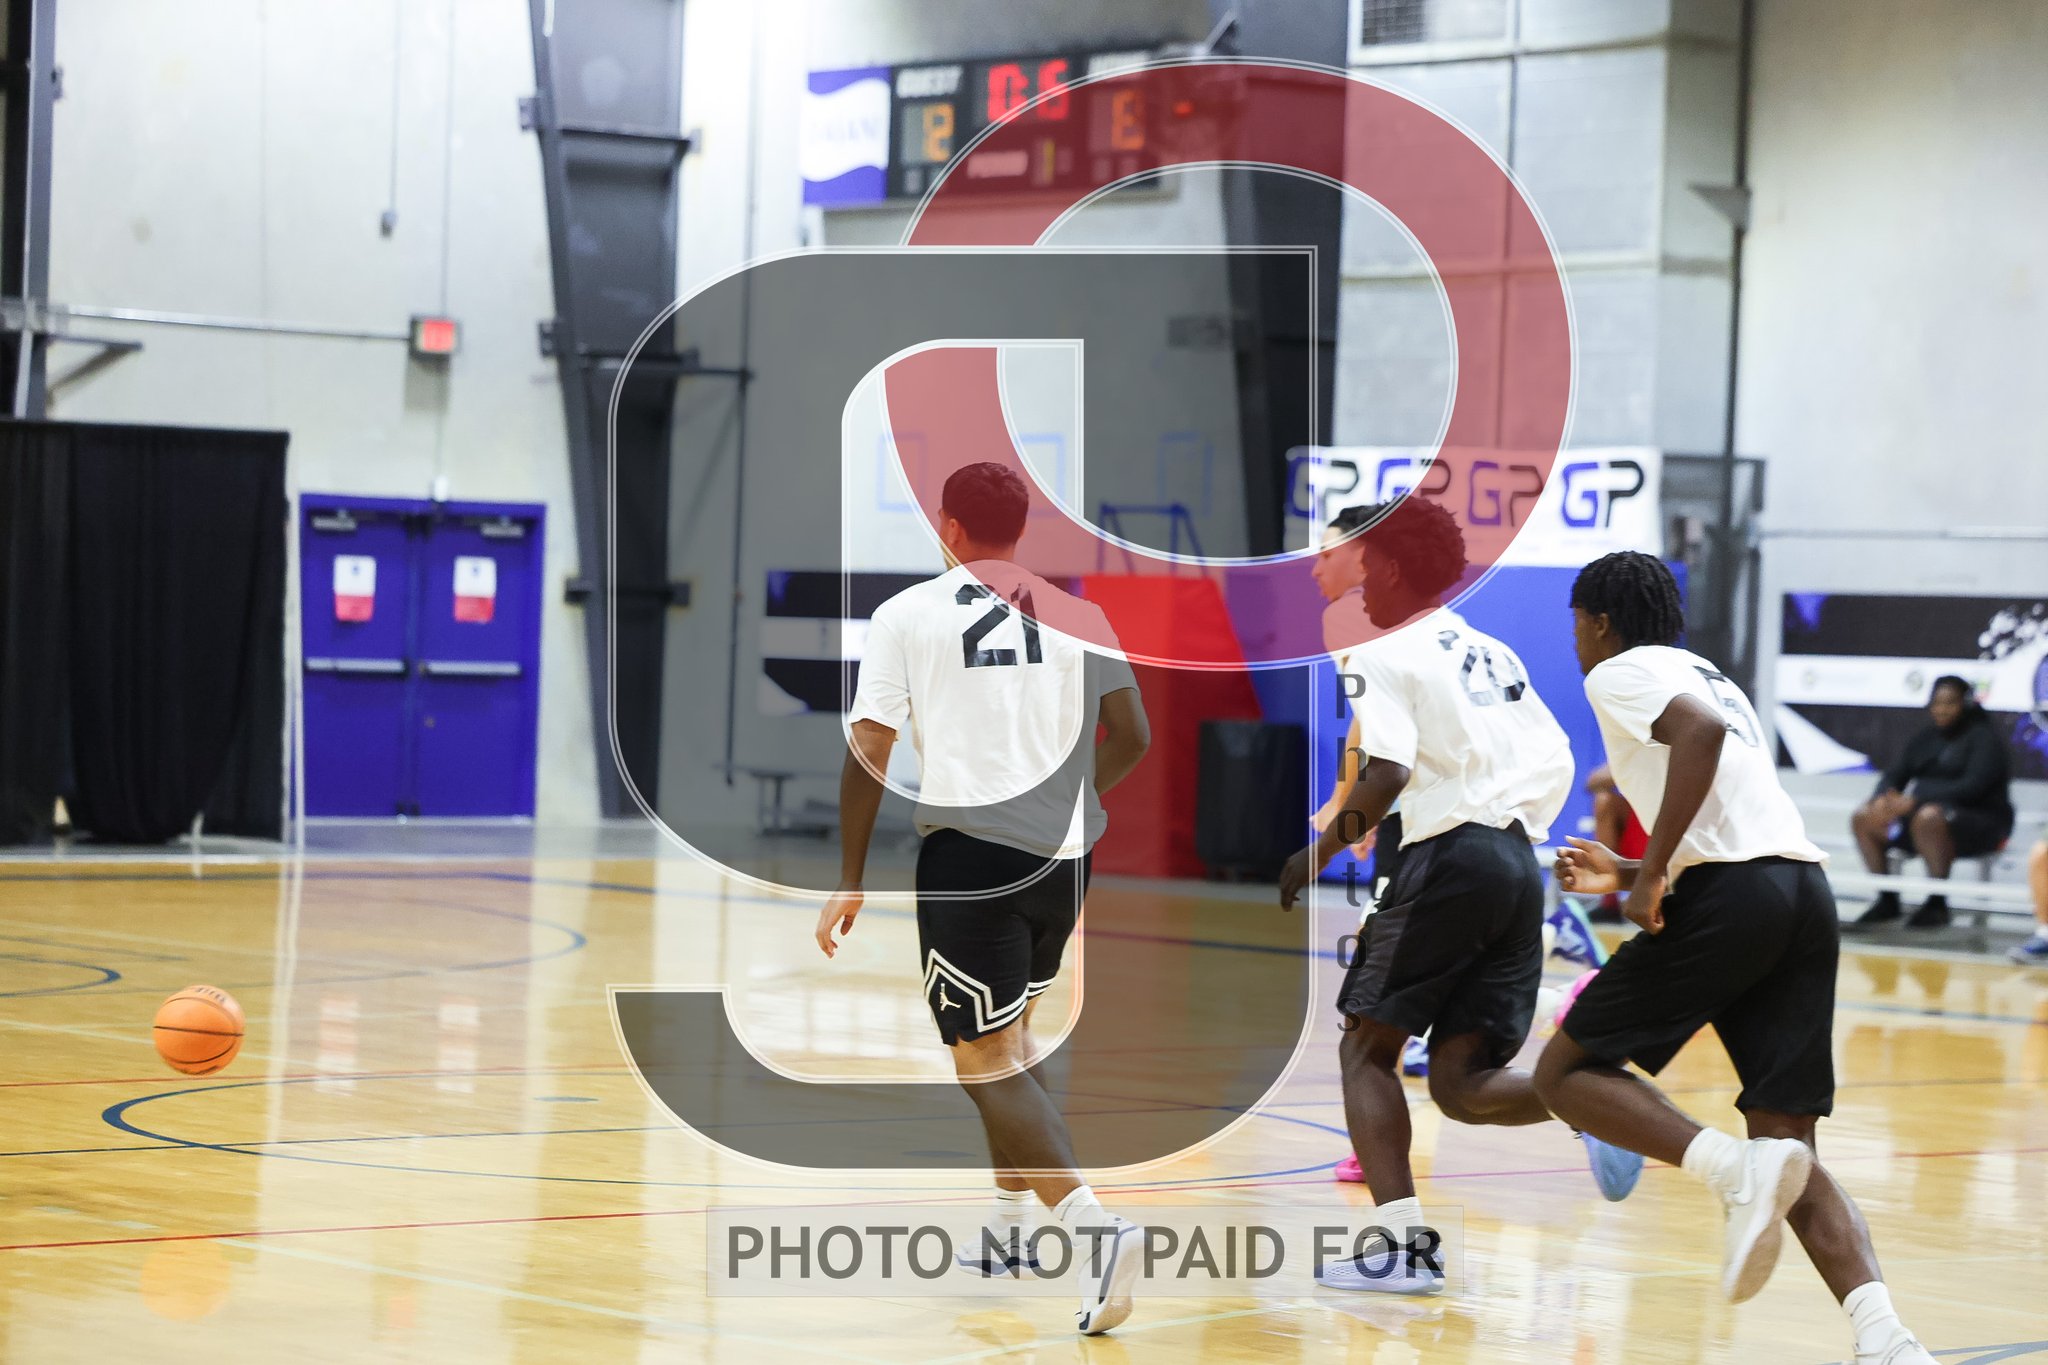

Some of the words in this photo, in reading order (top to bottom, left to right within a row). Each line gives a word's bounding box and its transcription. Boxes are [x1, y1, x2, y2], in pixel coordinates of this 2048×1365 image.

[1469, 461, 1544, 527] GP
[1562, 460, 1645, 528] GP
[955, 583, 1043, 668] 21
